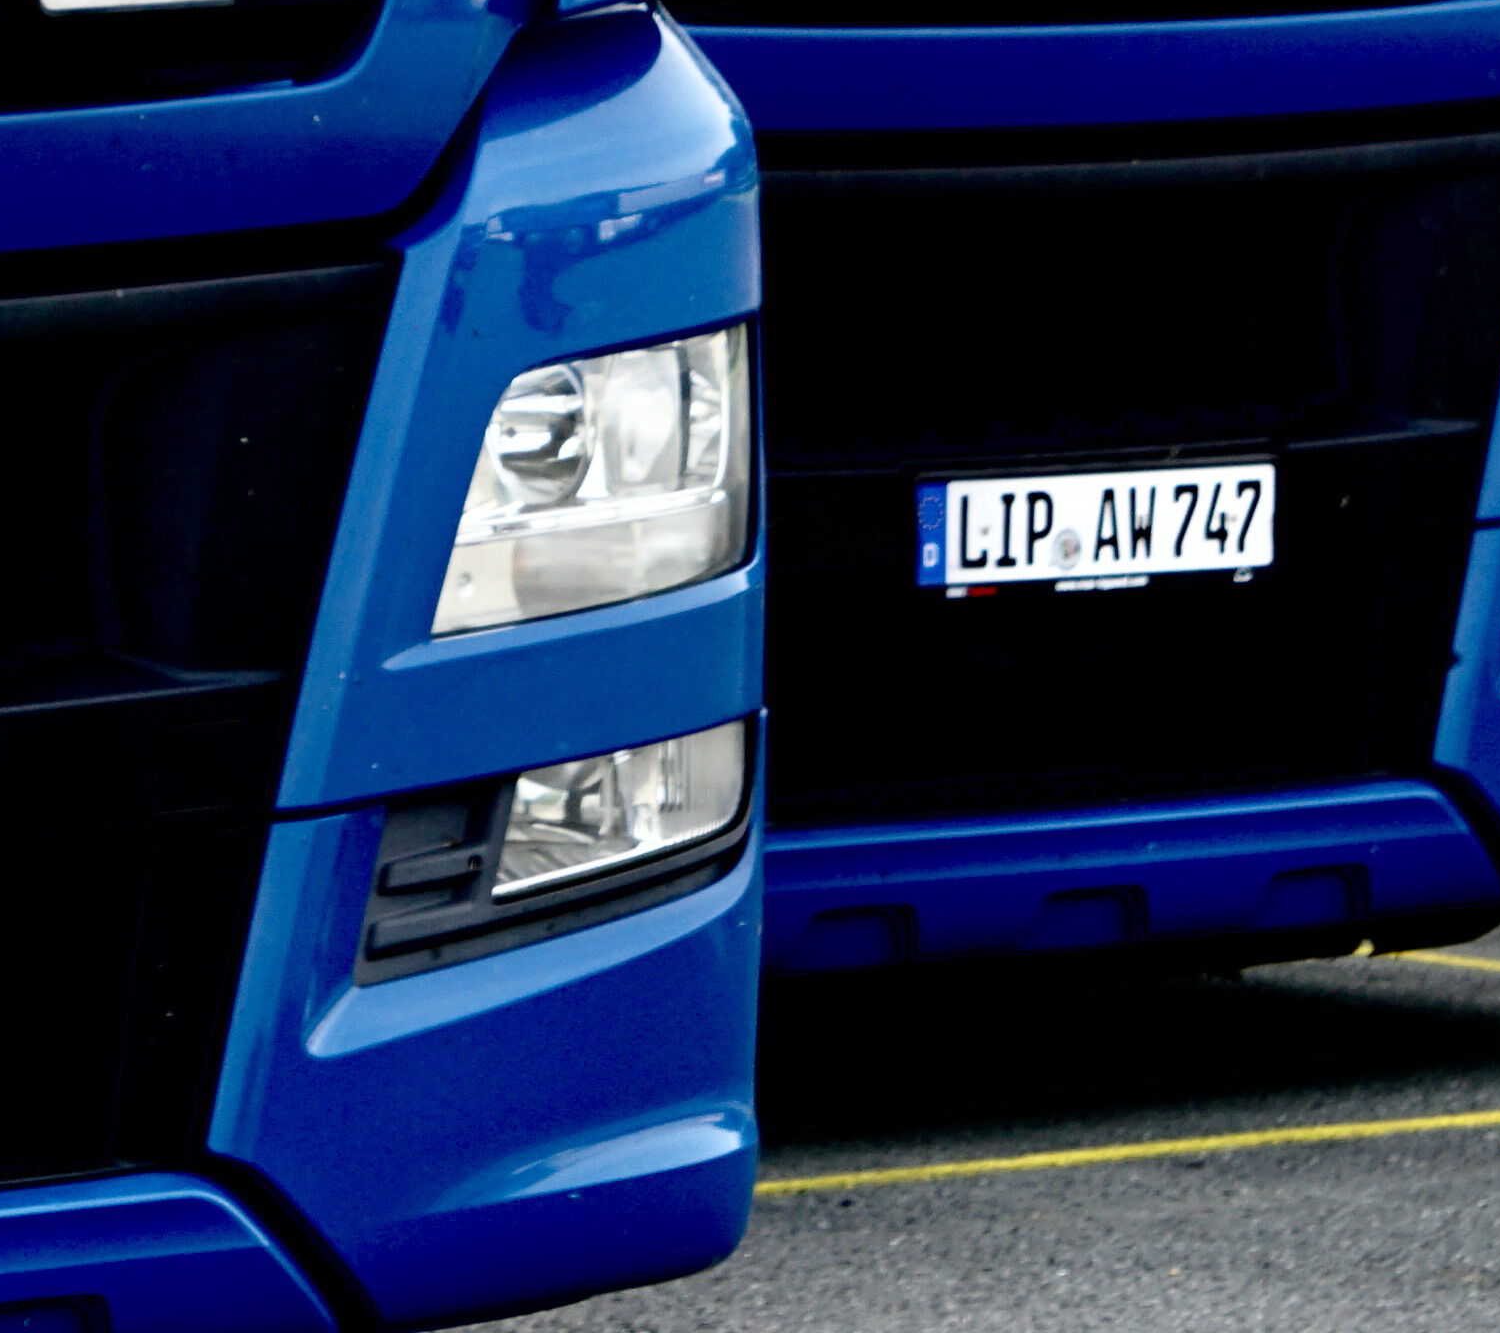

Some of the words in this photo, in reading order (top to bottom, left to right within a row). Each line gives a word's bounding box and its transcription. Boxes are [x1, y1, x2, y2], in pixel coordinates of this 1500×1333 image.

[958, 489, 1055, 570] LIP
[1092, 486, 1157, 562] AW
[1172, 479, 1263, 558] 747
